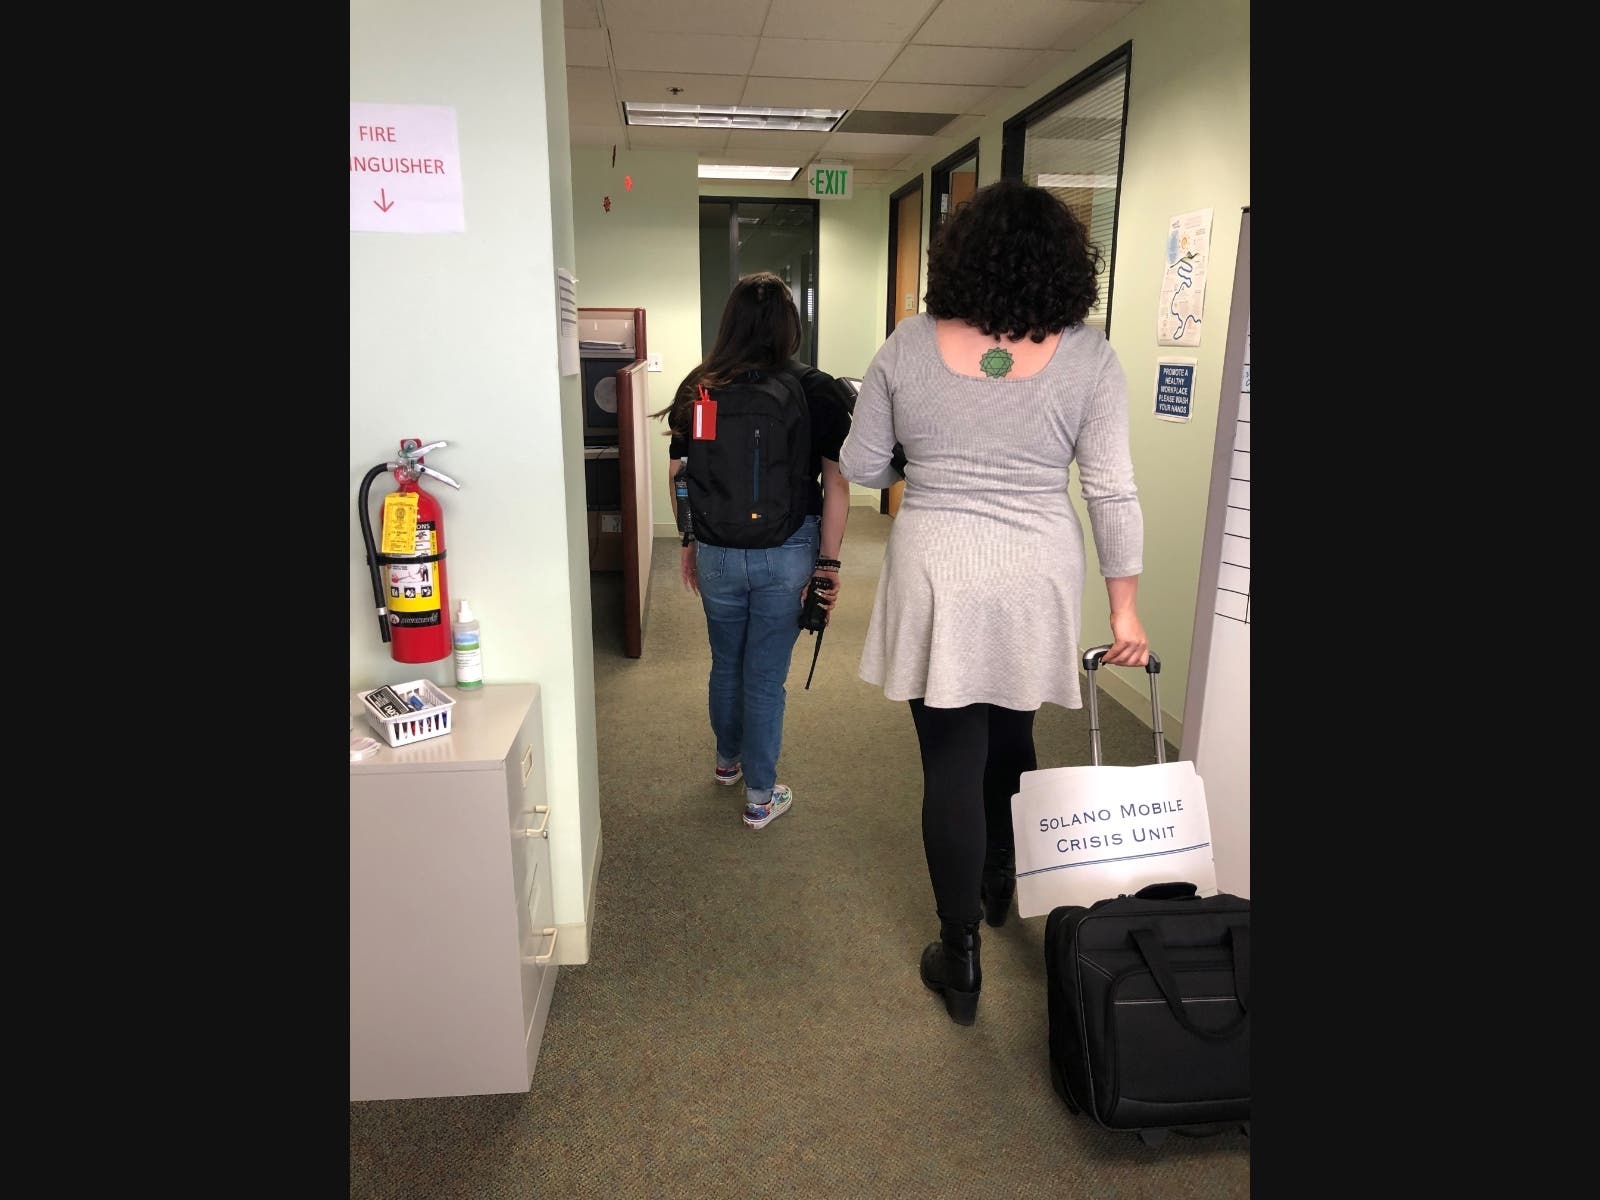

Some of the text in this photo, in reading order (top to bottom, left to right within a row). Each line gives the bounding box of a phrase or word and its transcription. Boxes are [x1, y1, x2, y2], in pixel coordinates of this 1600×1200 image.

[359, 125, 397, 142] FIRE
[816, 169, 848, 195] EXIT
[1163, 368, 1184, 376] PROMOTE
[1165, 377, 1185, 385] HEALTHY
[1160, 385, 1188, 395] WORKPLACE
[1159, 394, 1189, 404] PLEASE WASH
[1160, 403, 1187, 414] YOUR HANDS
[1039, 799, 1184, 832] SOLANO MOBILE
[1056, 825, 1176, 853] CRISIS UNIT
